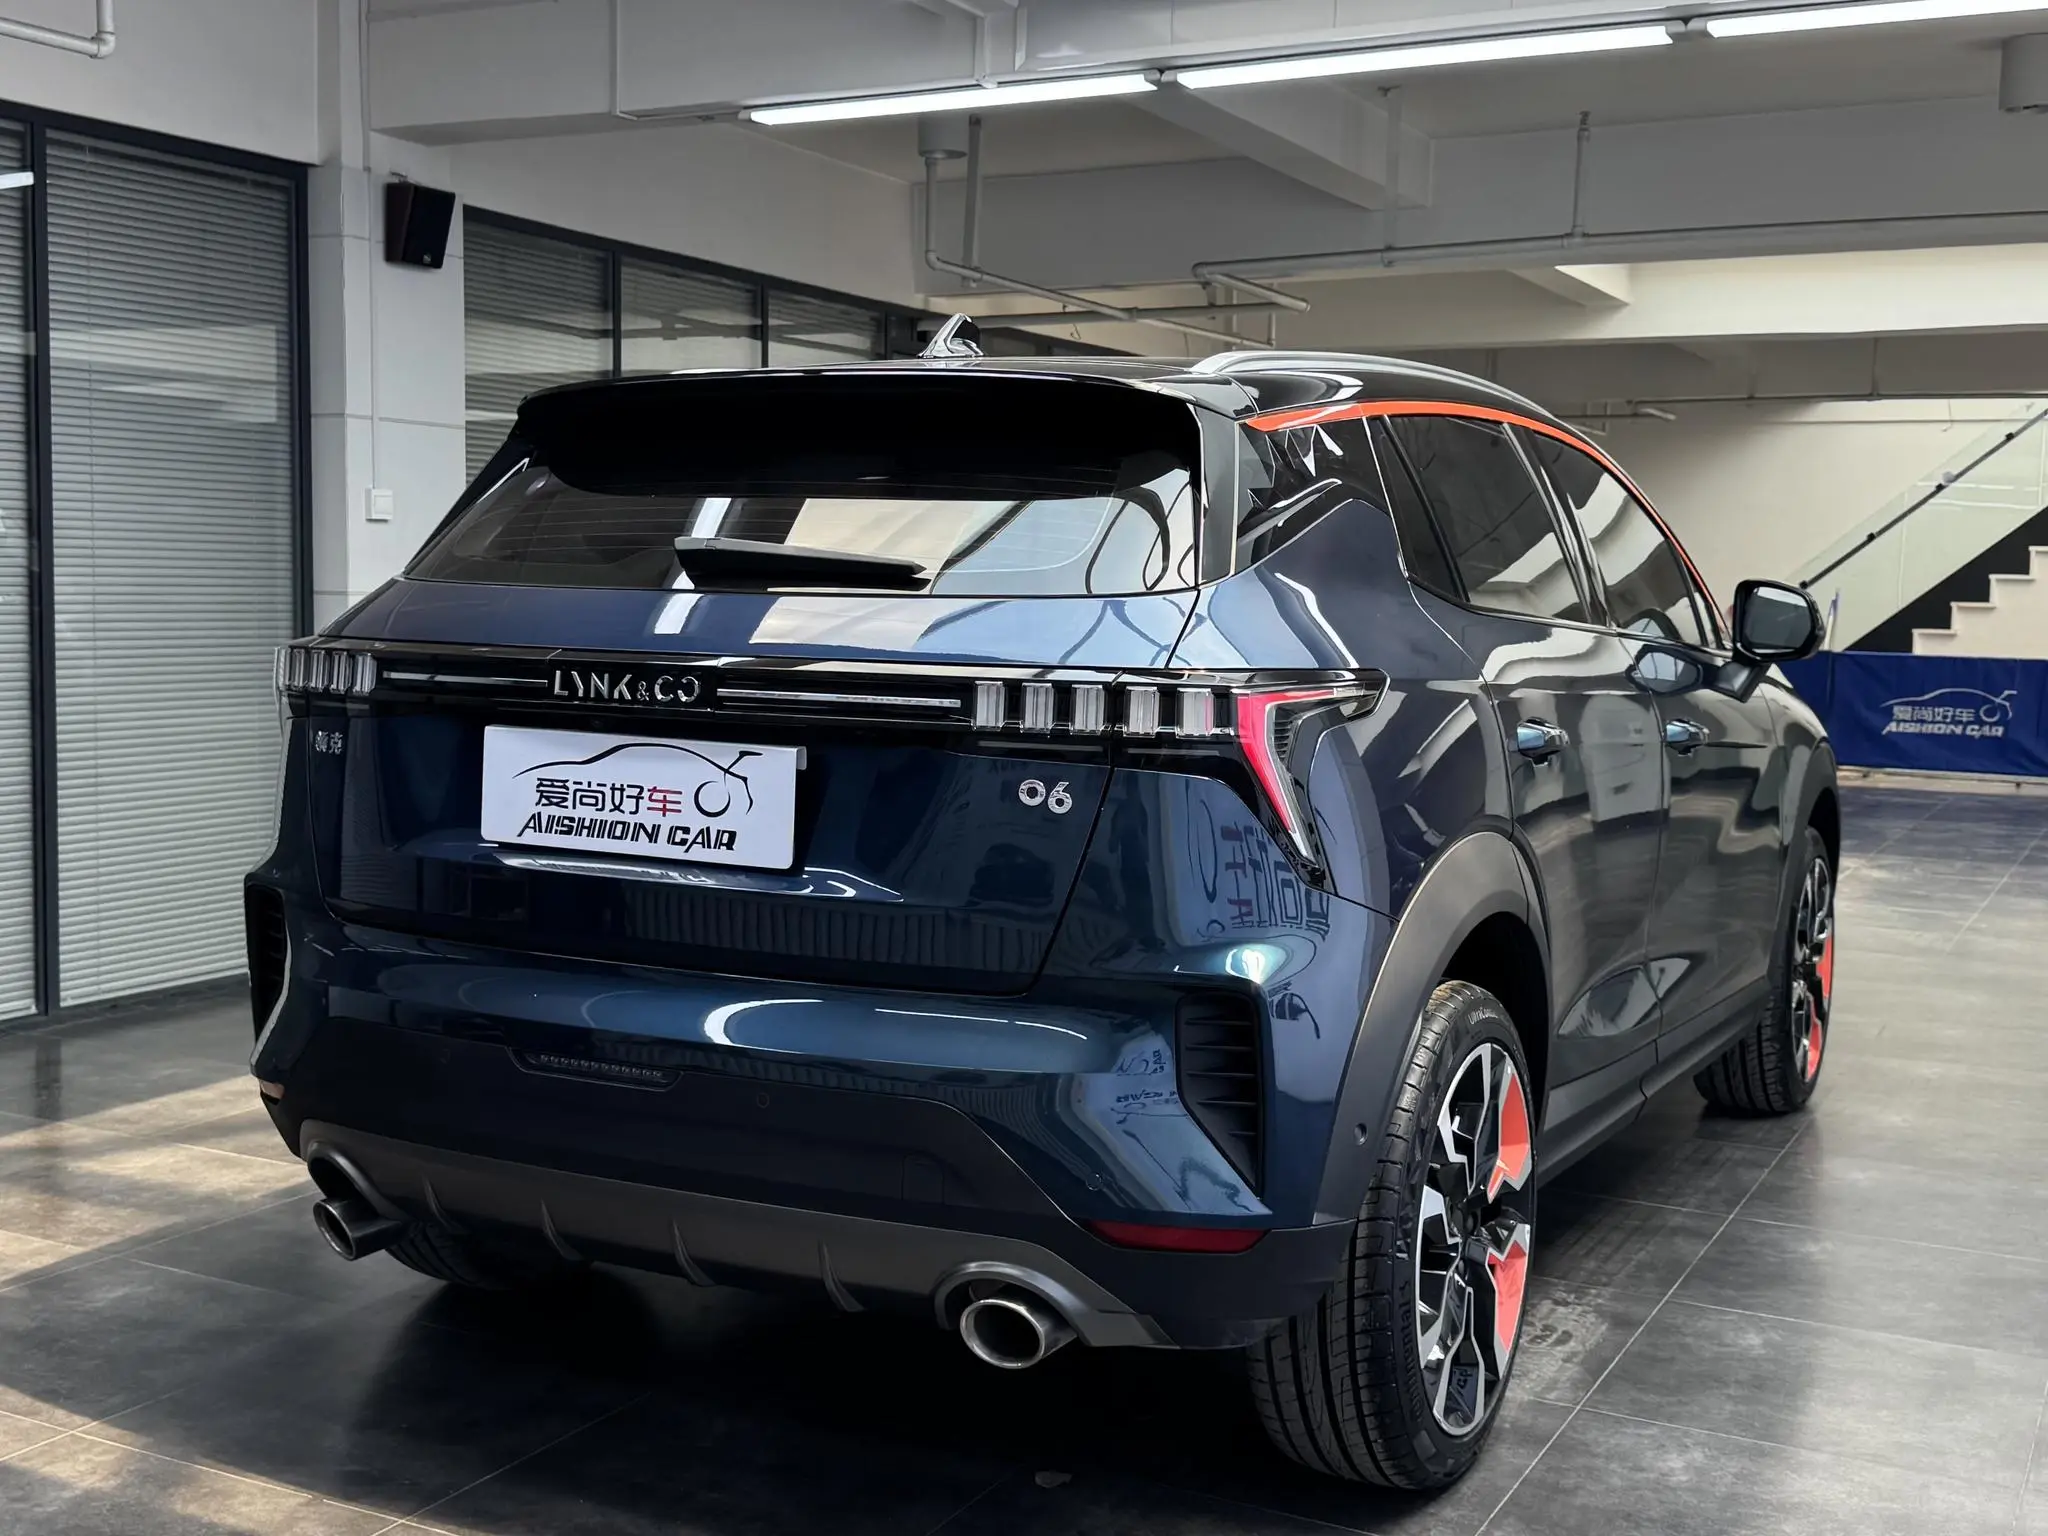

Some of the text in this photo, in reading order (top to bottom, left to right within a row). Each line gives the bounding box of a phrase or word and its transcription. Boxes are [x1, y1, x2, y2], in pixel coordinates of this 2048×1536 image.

[553, 669, 700, 703] LYNK&CO
[1881, 720, 2004, 739] AISHION CAR
[1892, 705, 1976, 722] 爱尚好车
[535, 777, 683, 817] 爱尚好车
[1018, 779, 1073, 814] 06
[517, 811, 737, 853] AISHION CAR
